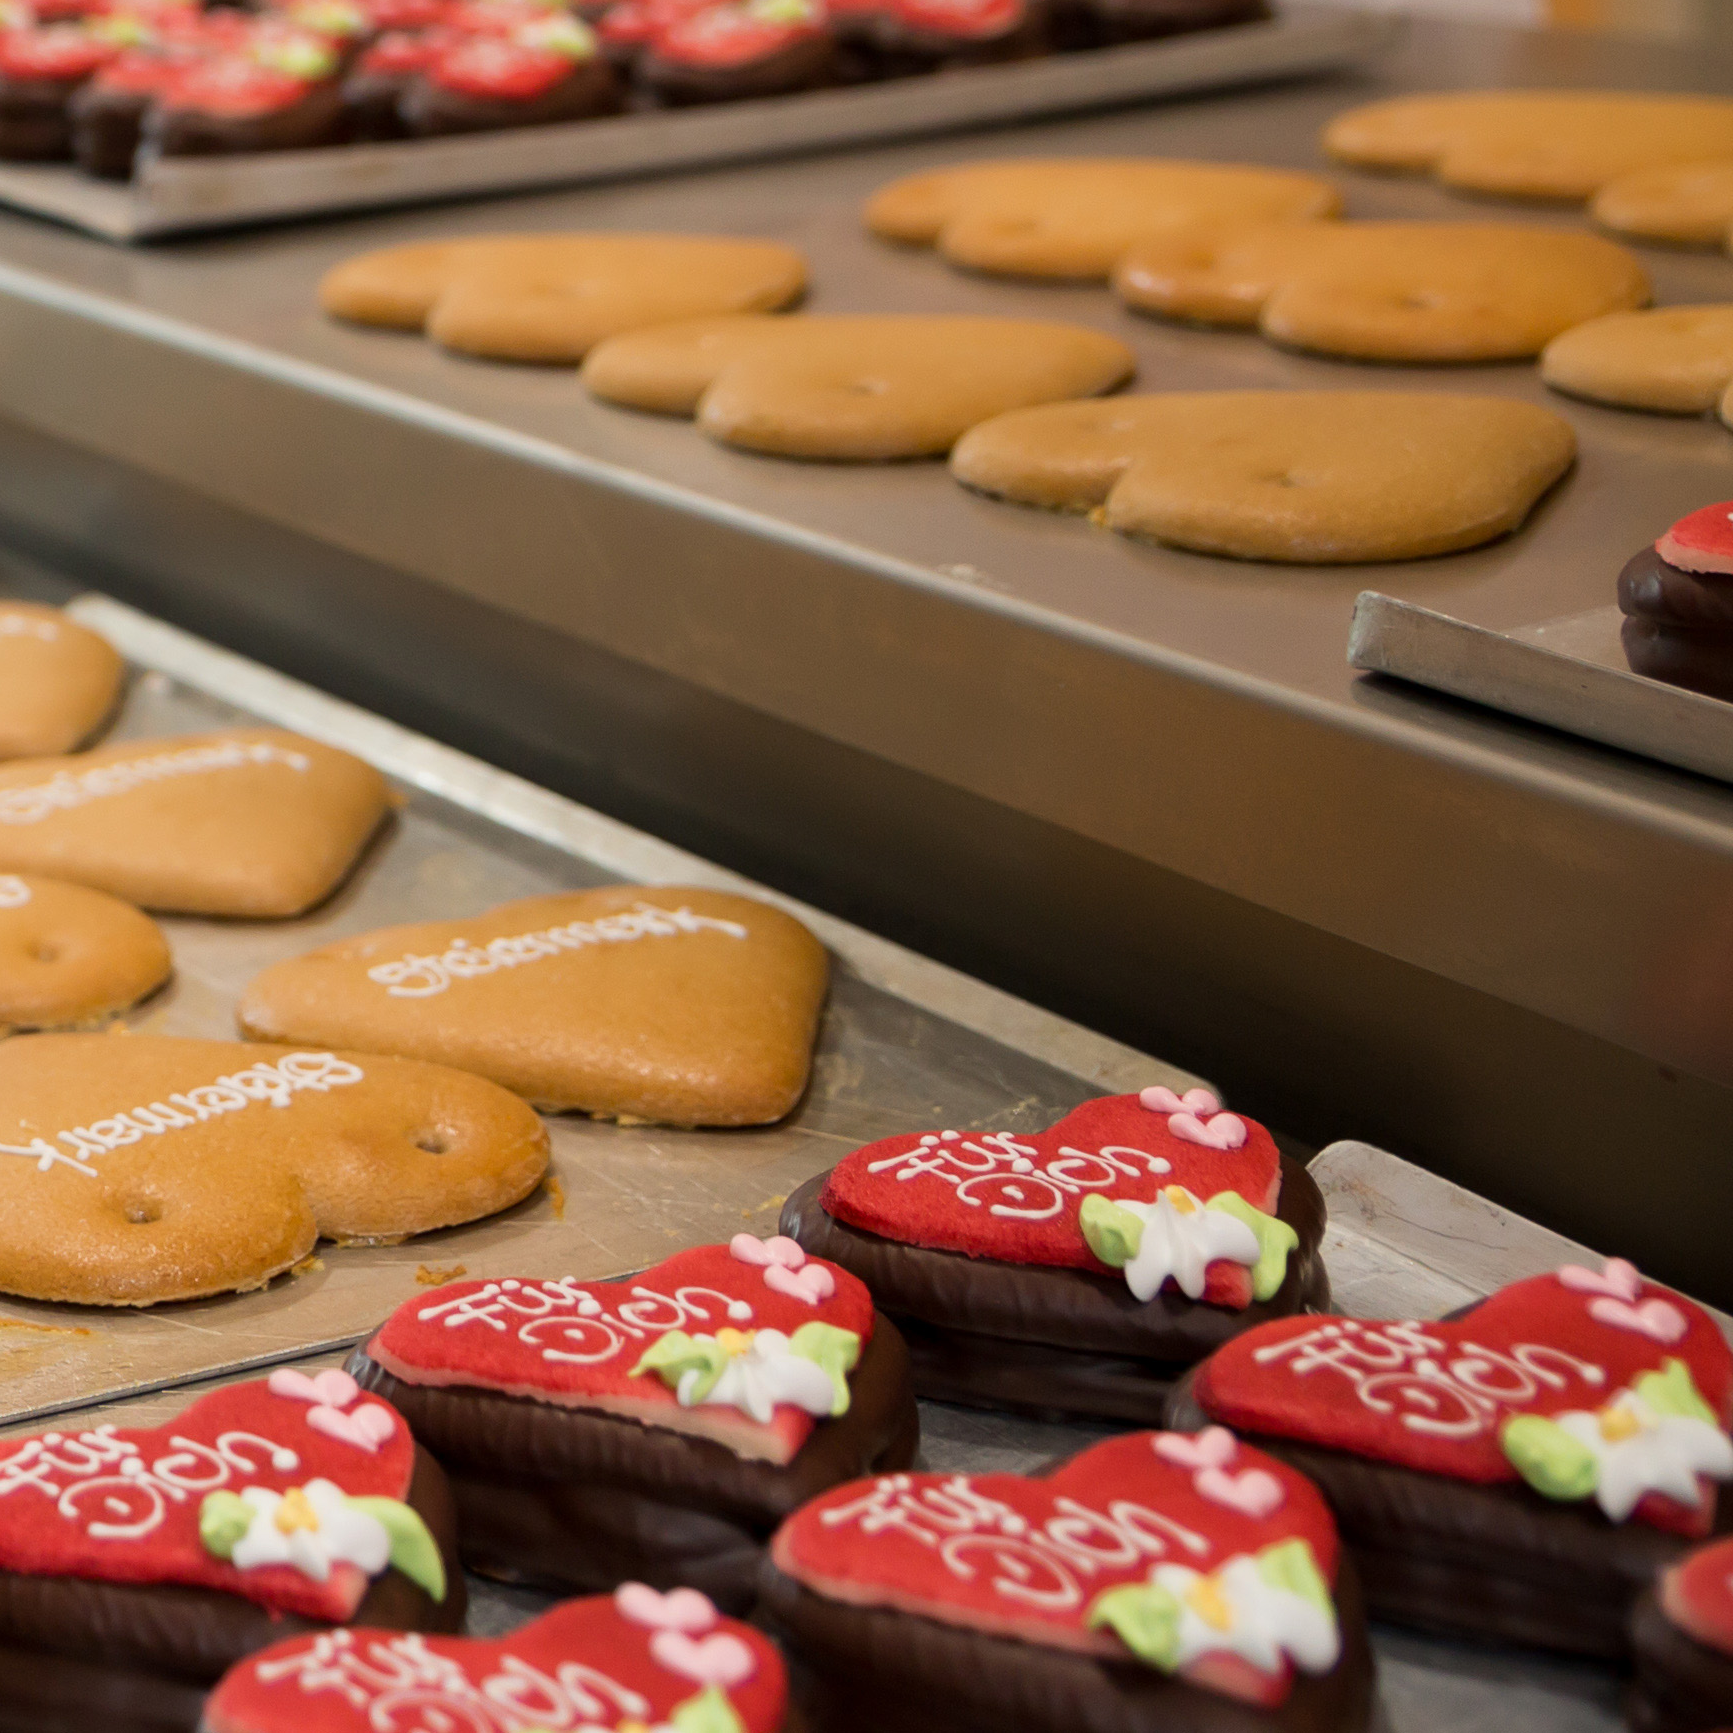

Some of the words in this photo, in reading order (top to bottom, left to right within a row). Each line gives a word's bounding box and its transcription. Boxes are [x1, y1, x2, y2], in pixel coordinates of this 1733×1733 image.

[367, 902, 748, 997] Steiermark
[866, 1129, 1039, 1185] Für
[417, 1274, 593, 1331] Für
[1253, 1320, 1446, 1381] Für
[819, 1474, 1013, 1547] Für
